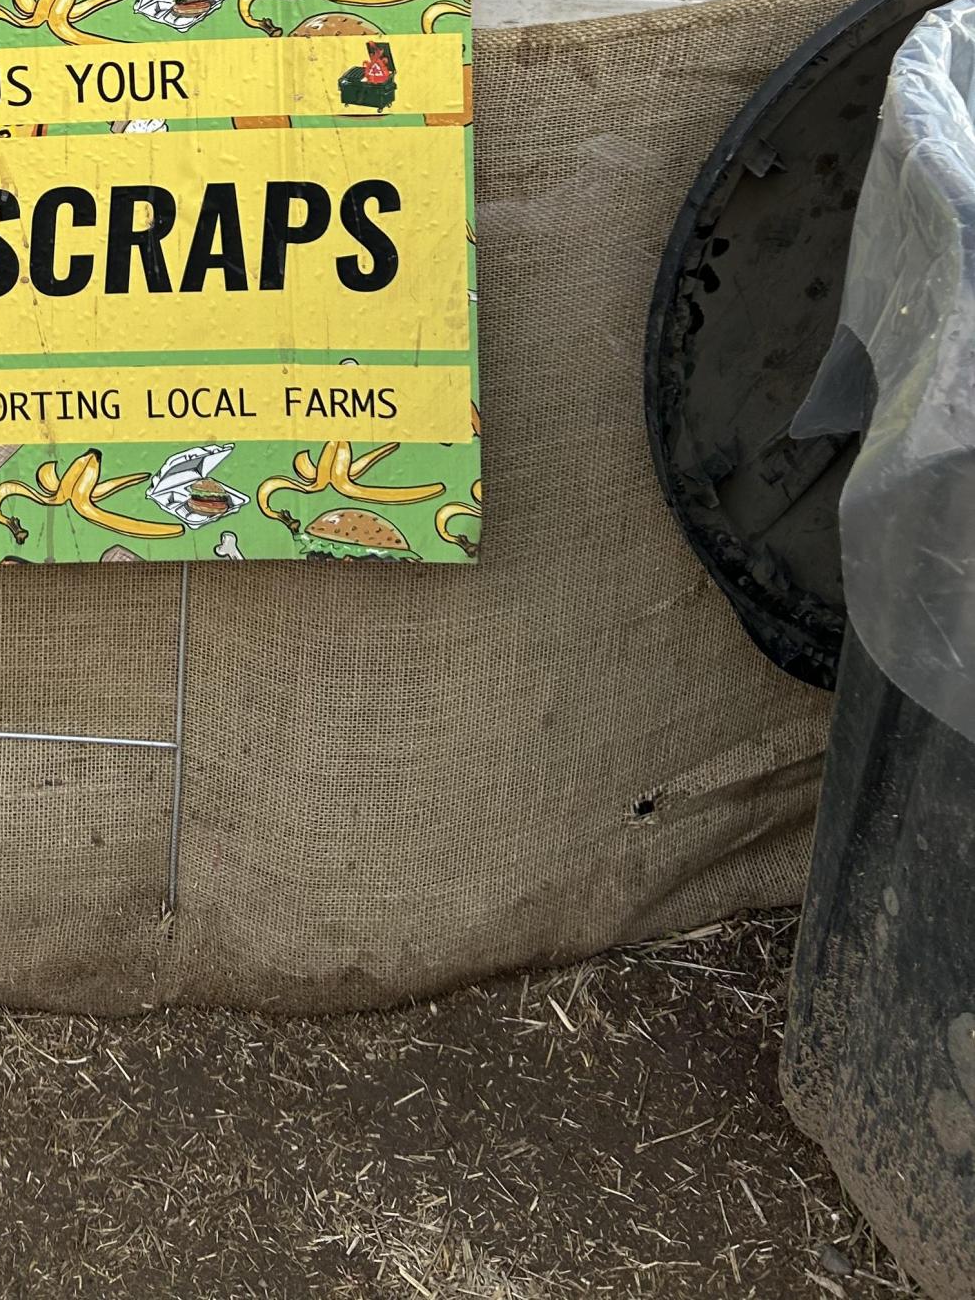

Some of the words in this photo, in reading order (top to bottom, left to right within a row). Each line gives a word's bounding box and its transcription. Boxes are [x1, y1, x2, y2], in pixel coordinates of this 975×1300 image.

[66, 61, 188, 102] YOUR
[148, 388, 256, 418] LOCAL
[286, 388, 396, 418] FARMS
